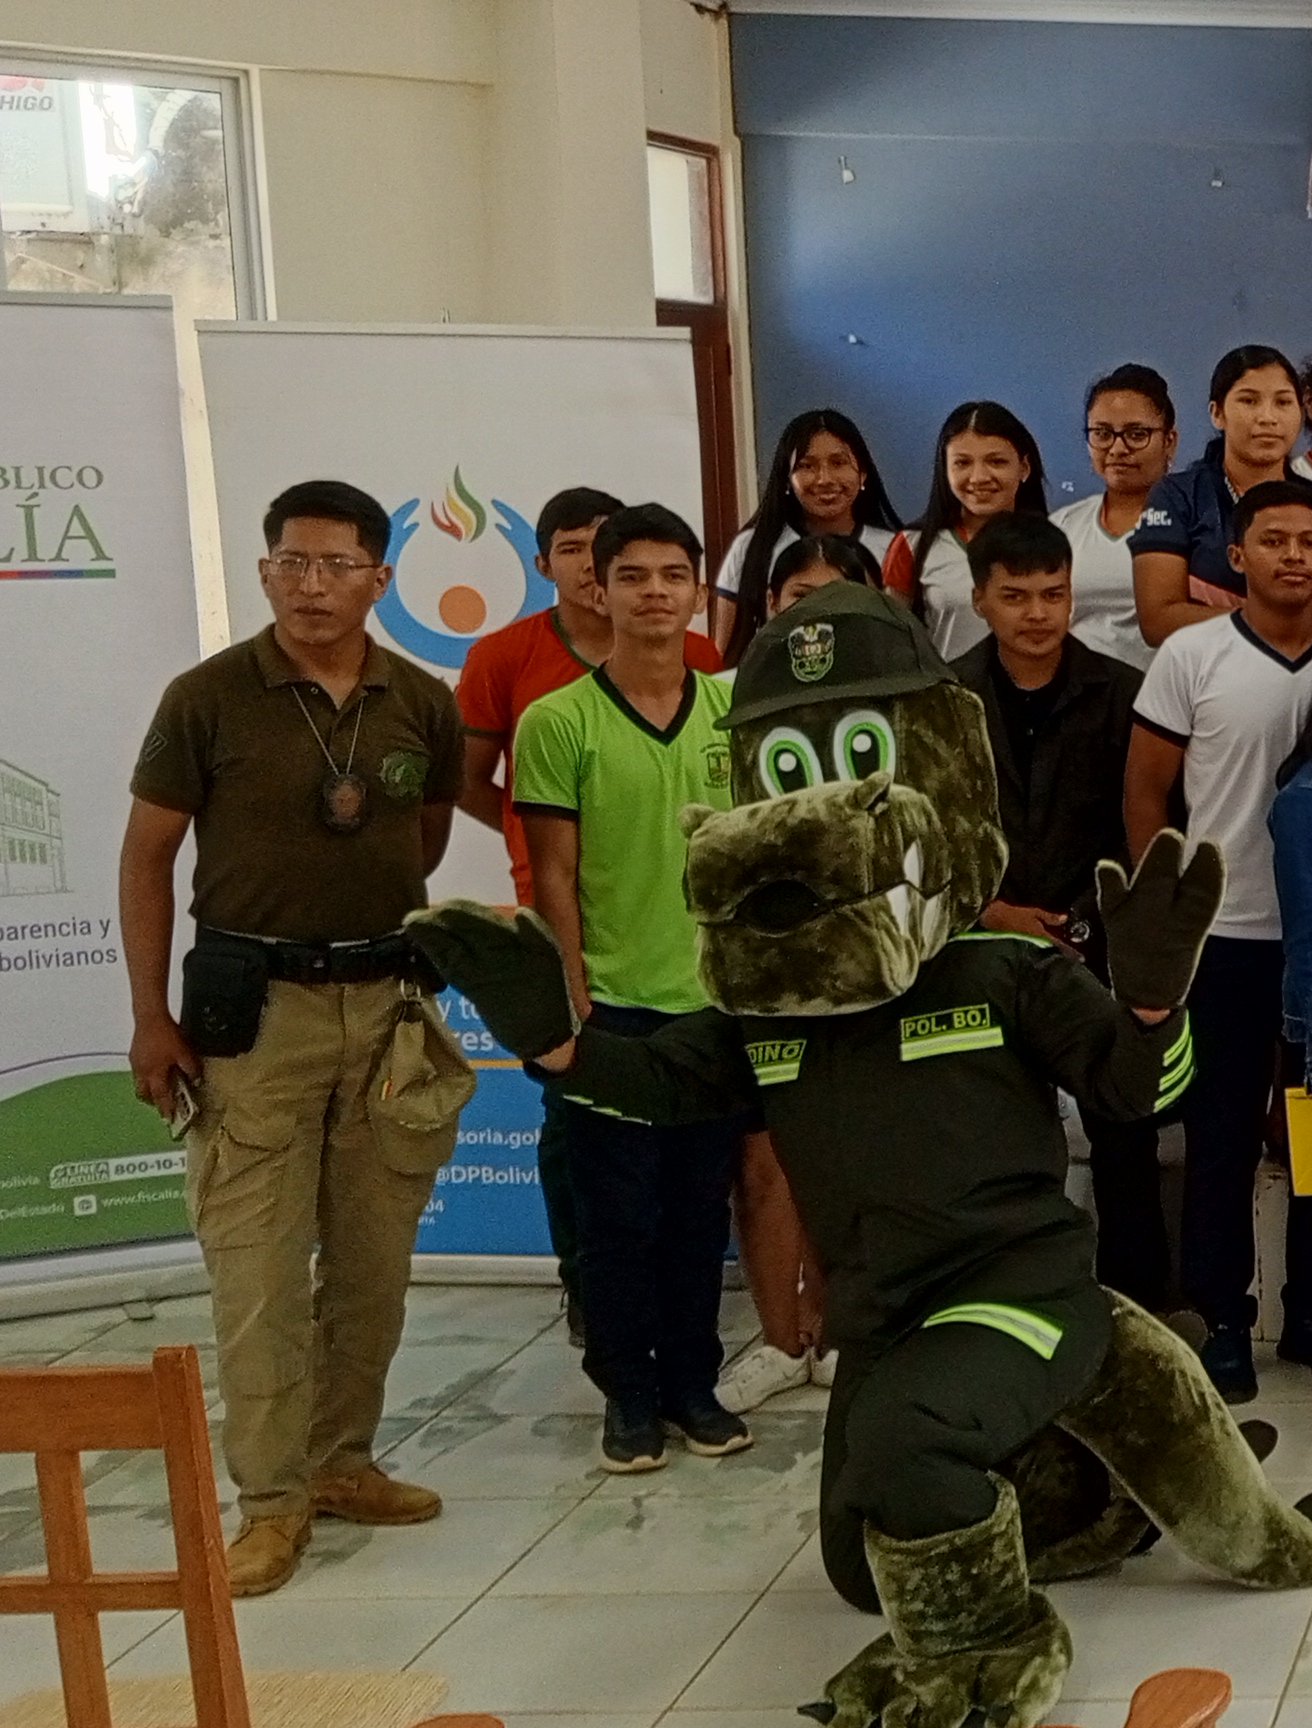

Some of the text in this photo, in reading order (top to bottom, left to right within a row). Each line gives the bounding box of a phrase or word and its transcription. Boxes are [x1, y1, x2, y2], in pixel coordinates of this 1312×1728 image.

[99, 918, 111, 939] y
[0, 948, 118, 972] bolivianos
[905, 1010, 988, 1037] POL. BO.
[453, 1031, 494, 1052] es
[748, 1045, 800, 1064] DINO
